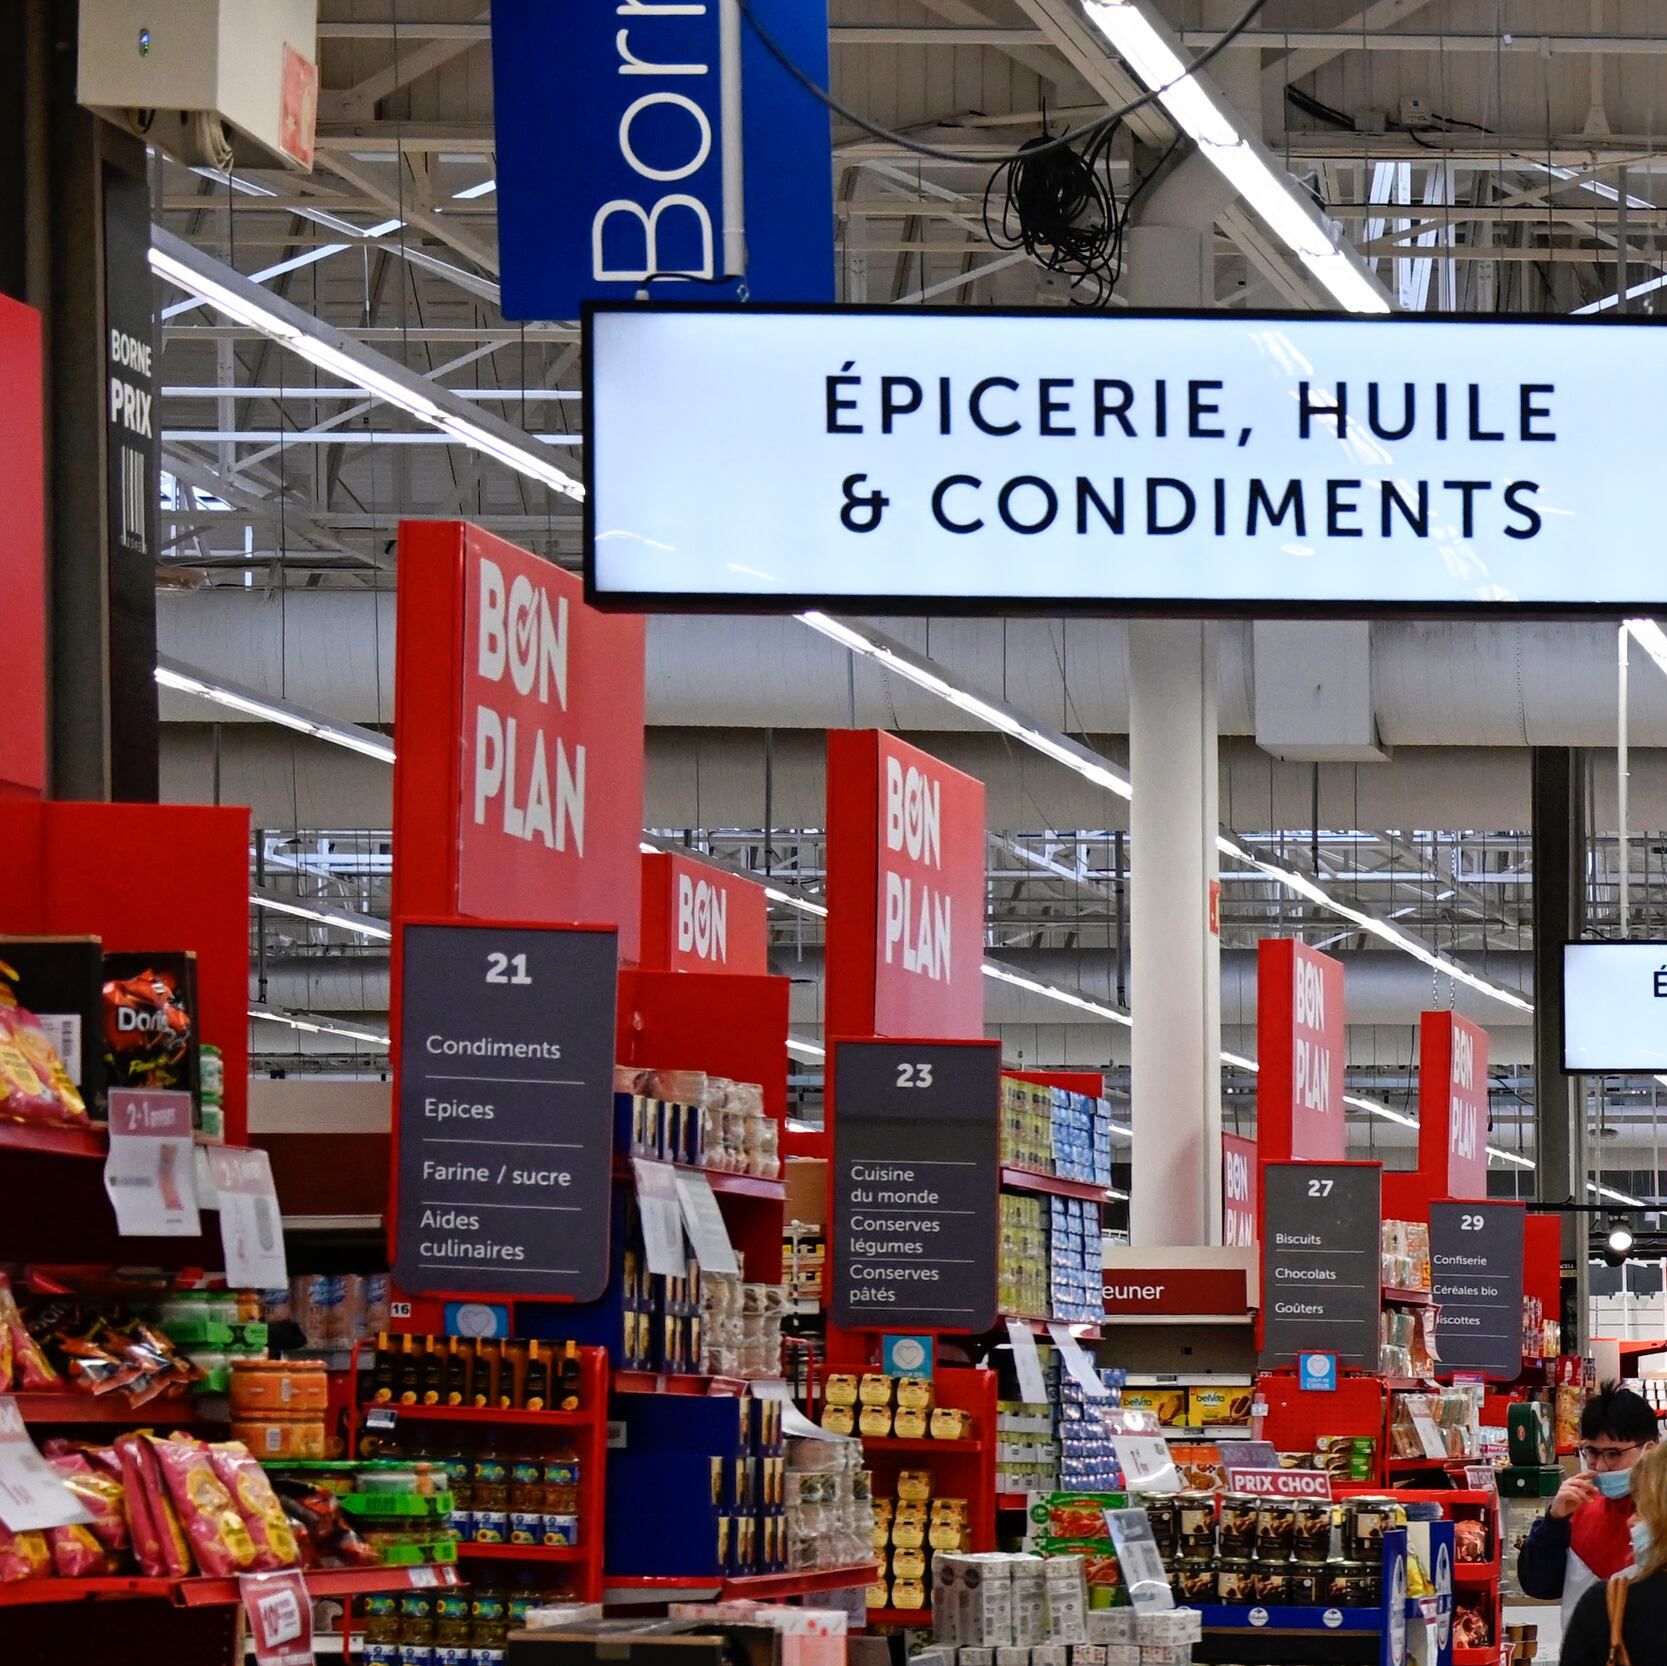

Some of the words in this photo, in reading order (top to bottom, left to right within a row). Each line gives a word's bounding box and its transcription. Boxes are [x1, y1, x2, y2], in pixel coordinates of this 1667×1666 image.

[592, 0, 713, 281] Bor
[111, 329, 152, 377] BORNE
[111, 378, 152, 439] PRIX
[826, 361, 1252, 446] ÉPICERIE,
[1299, 382, 1556, 441] HUILE
[840, 474, 889, 533] &
[932, 475, 1541, 539] CONDIMENTS
[478, 557, 569, 712] BON
[474, 705, 586, 858] PLAN
[887, 755, 941, 871] BON
[678, 874, 727, 964] BON
[884, 879, 951, 985] PLAN
[485, 952, 532, 985] 21
[1296, 957, 1325, 1031] BON
[426, 1035, 561, 1059] Condiments
[1453, 1027, 1474, 1091] BON
[896, 1063, 933, 1088] 23
[1295, 1039, 1329, 1113] PLAN
[425, 1099, 495, 1121] Epices
[1452, 1096, 1477, 1160] PLAN
[423, 1161, 489, 1183] Farine
[497, 1166, 506, 1184] /
[512, 1170, 572, 1186] sucre
[851, 1166, 915, 1182] Cuisine
[1226, 1150, 1248, 1203] BON
[851, 1189, 873, 1203] du
[878, 1190, 939, 1204] monde
[1308, 1179, 1334, 1198] 27
[420, 1210, 479, 1230] Aides
[850, 1216, 940, 1233] Conserves
[1225, 1208, 1253, 1247] PLAN
[1460, 1215, 1485, 1231] 29
[420, 1240, 525, 1260] culinaires
[850, 1238, 923, 1257] légumes
[1275, 1233, 1321, 1246] Biscuits
[1433, 1254, 1487, 1266] Confiserie
[849, 1264, 939, 1281] Conserves
[1275, 1267, 1336, 1281] Chocolats
[849, 1286, 895, 1303] pâtés
[1433, 1284, 1479, 1297] Céréales
[1481, 1285, 1498, 1296] bio
[392, 1305, 409, 1315] 16
[1275, 1300, 1324, 1315] Goûters
[1234, 1473, 1271, 1490] PRIX
[1278, 1477, 1326, 1493] CHOC
